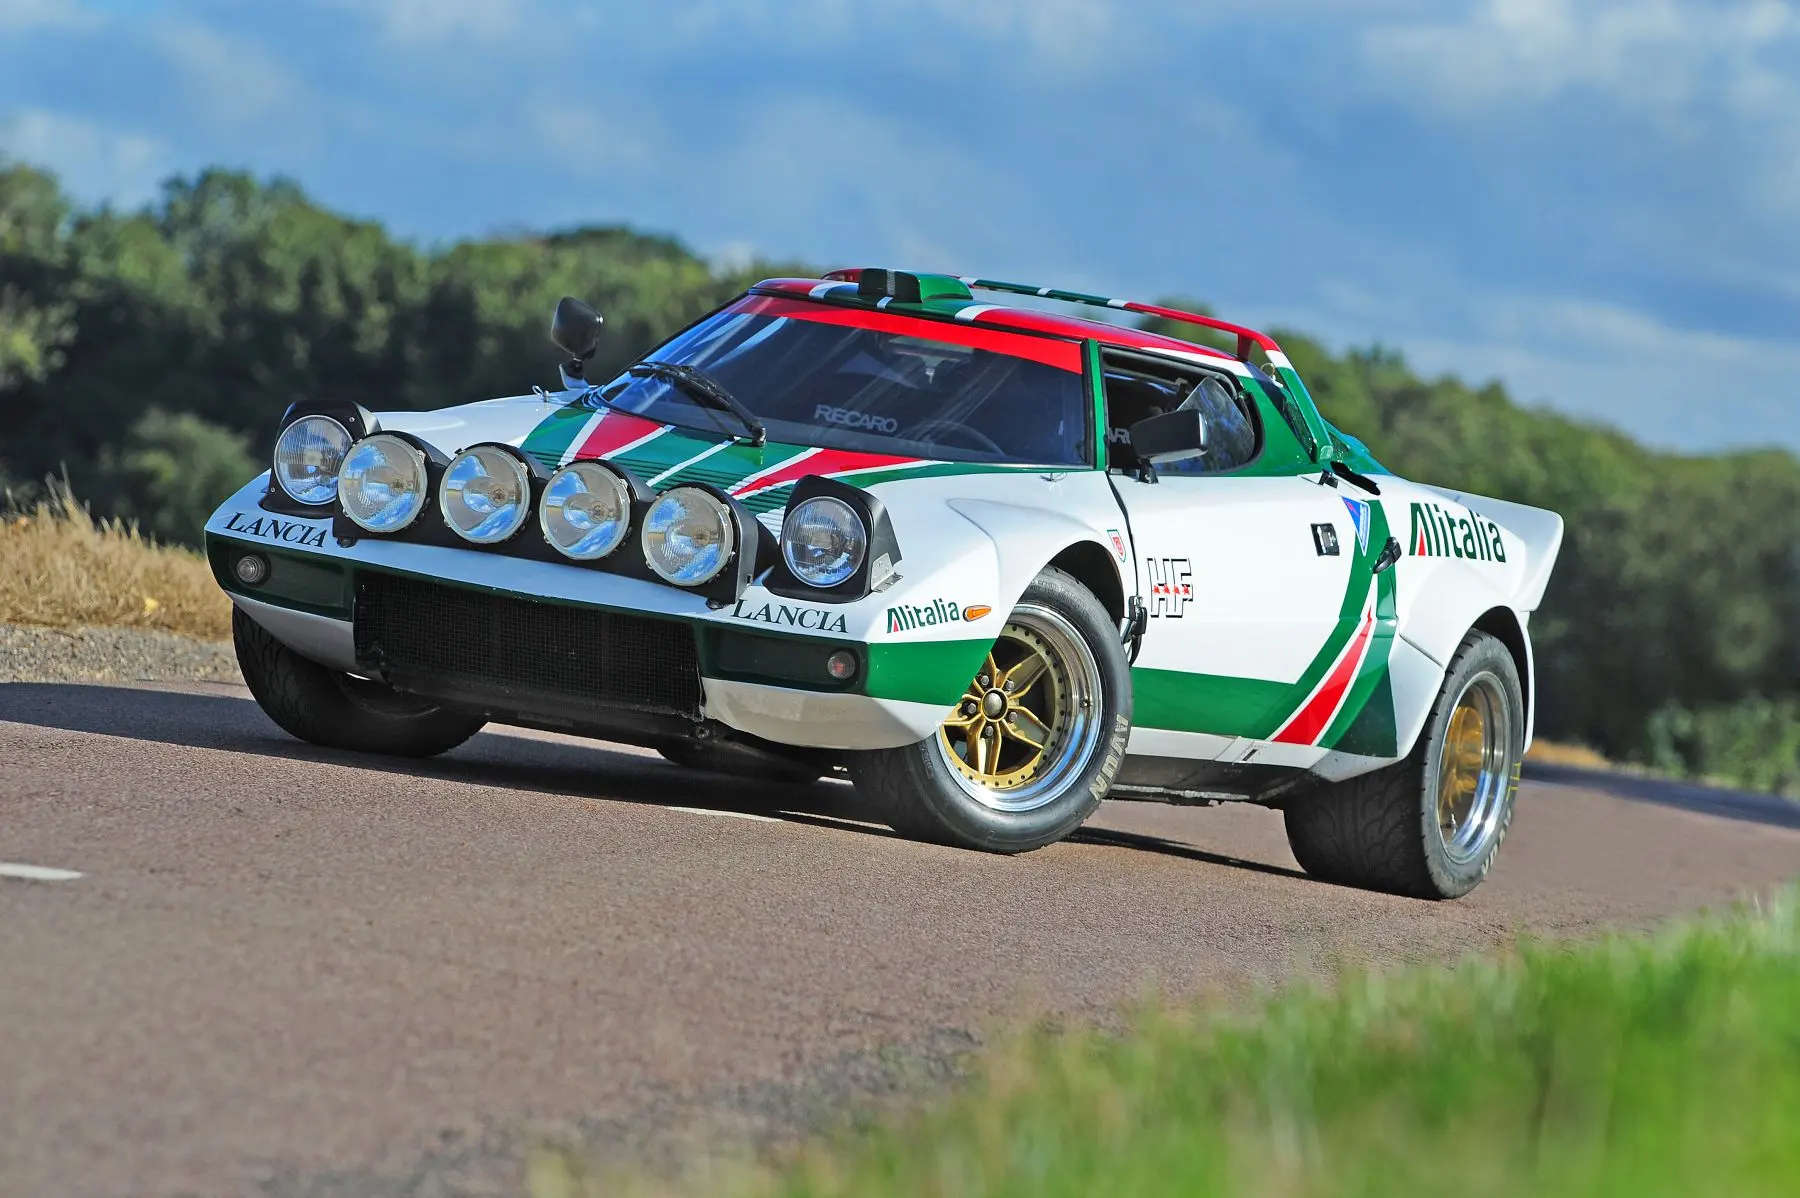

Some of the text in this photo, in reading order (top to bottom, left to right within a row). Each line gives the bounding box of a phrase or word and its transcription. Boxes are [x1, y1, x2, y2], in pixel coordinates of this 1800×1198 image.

[813, 404, 898, 433] RECARO
[224, 511, 328, 548] LANCIA
[1408, 502, 1507, 563] Alitalia
[1146, 557, 1194, 618] HF
[730, 599, 849, 634] LANCIA
[886, 598, 960, 634] Alitalia
[1088, 713, 1129, 801] AVON
